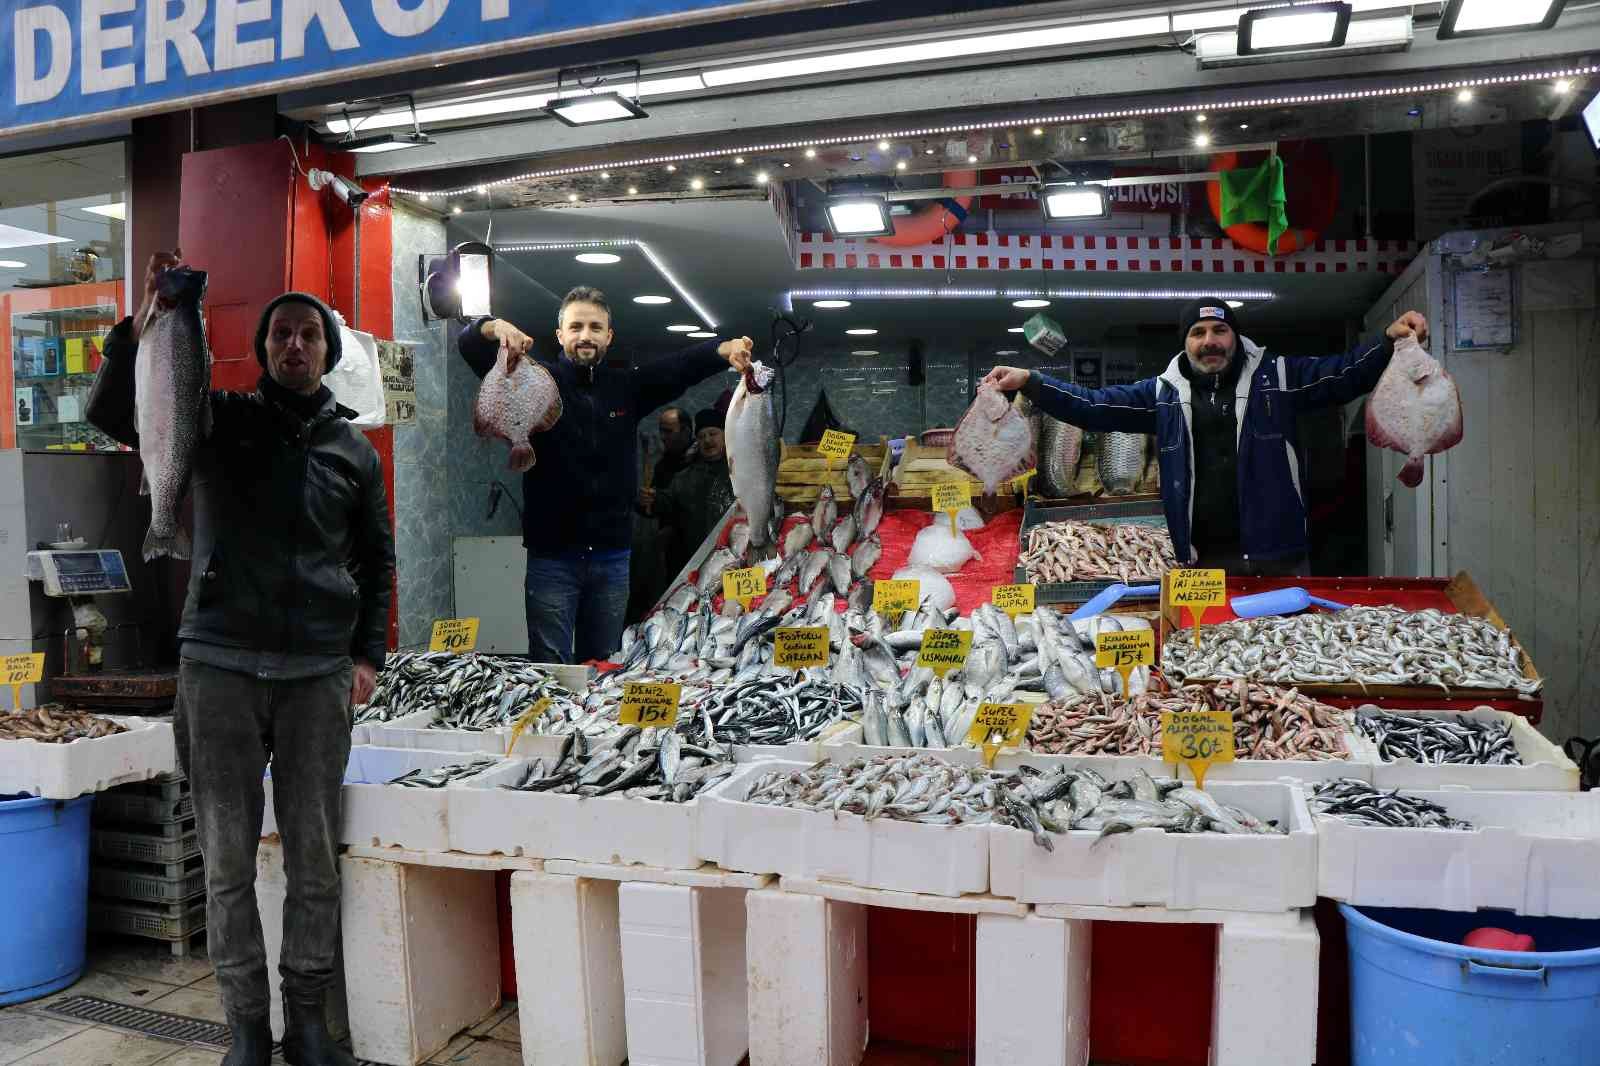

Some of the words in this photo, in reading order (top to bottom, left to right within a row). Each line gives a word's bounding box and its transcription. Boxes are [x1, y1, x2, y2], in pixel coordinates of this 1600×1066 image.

[13, 0, 510, 106] DEREK
[728, 570, 752, 579] TANE
[777, 651, 824, 664] SARGAN
